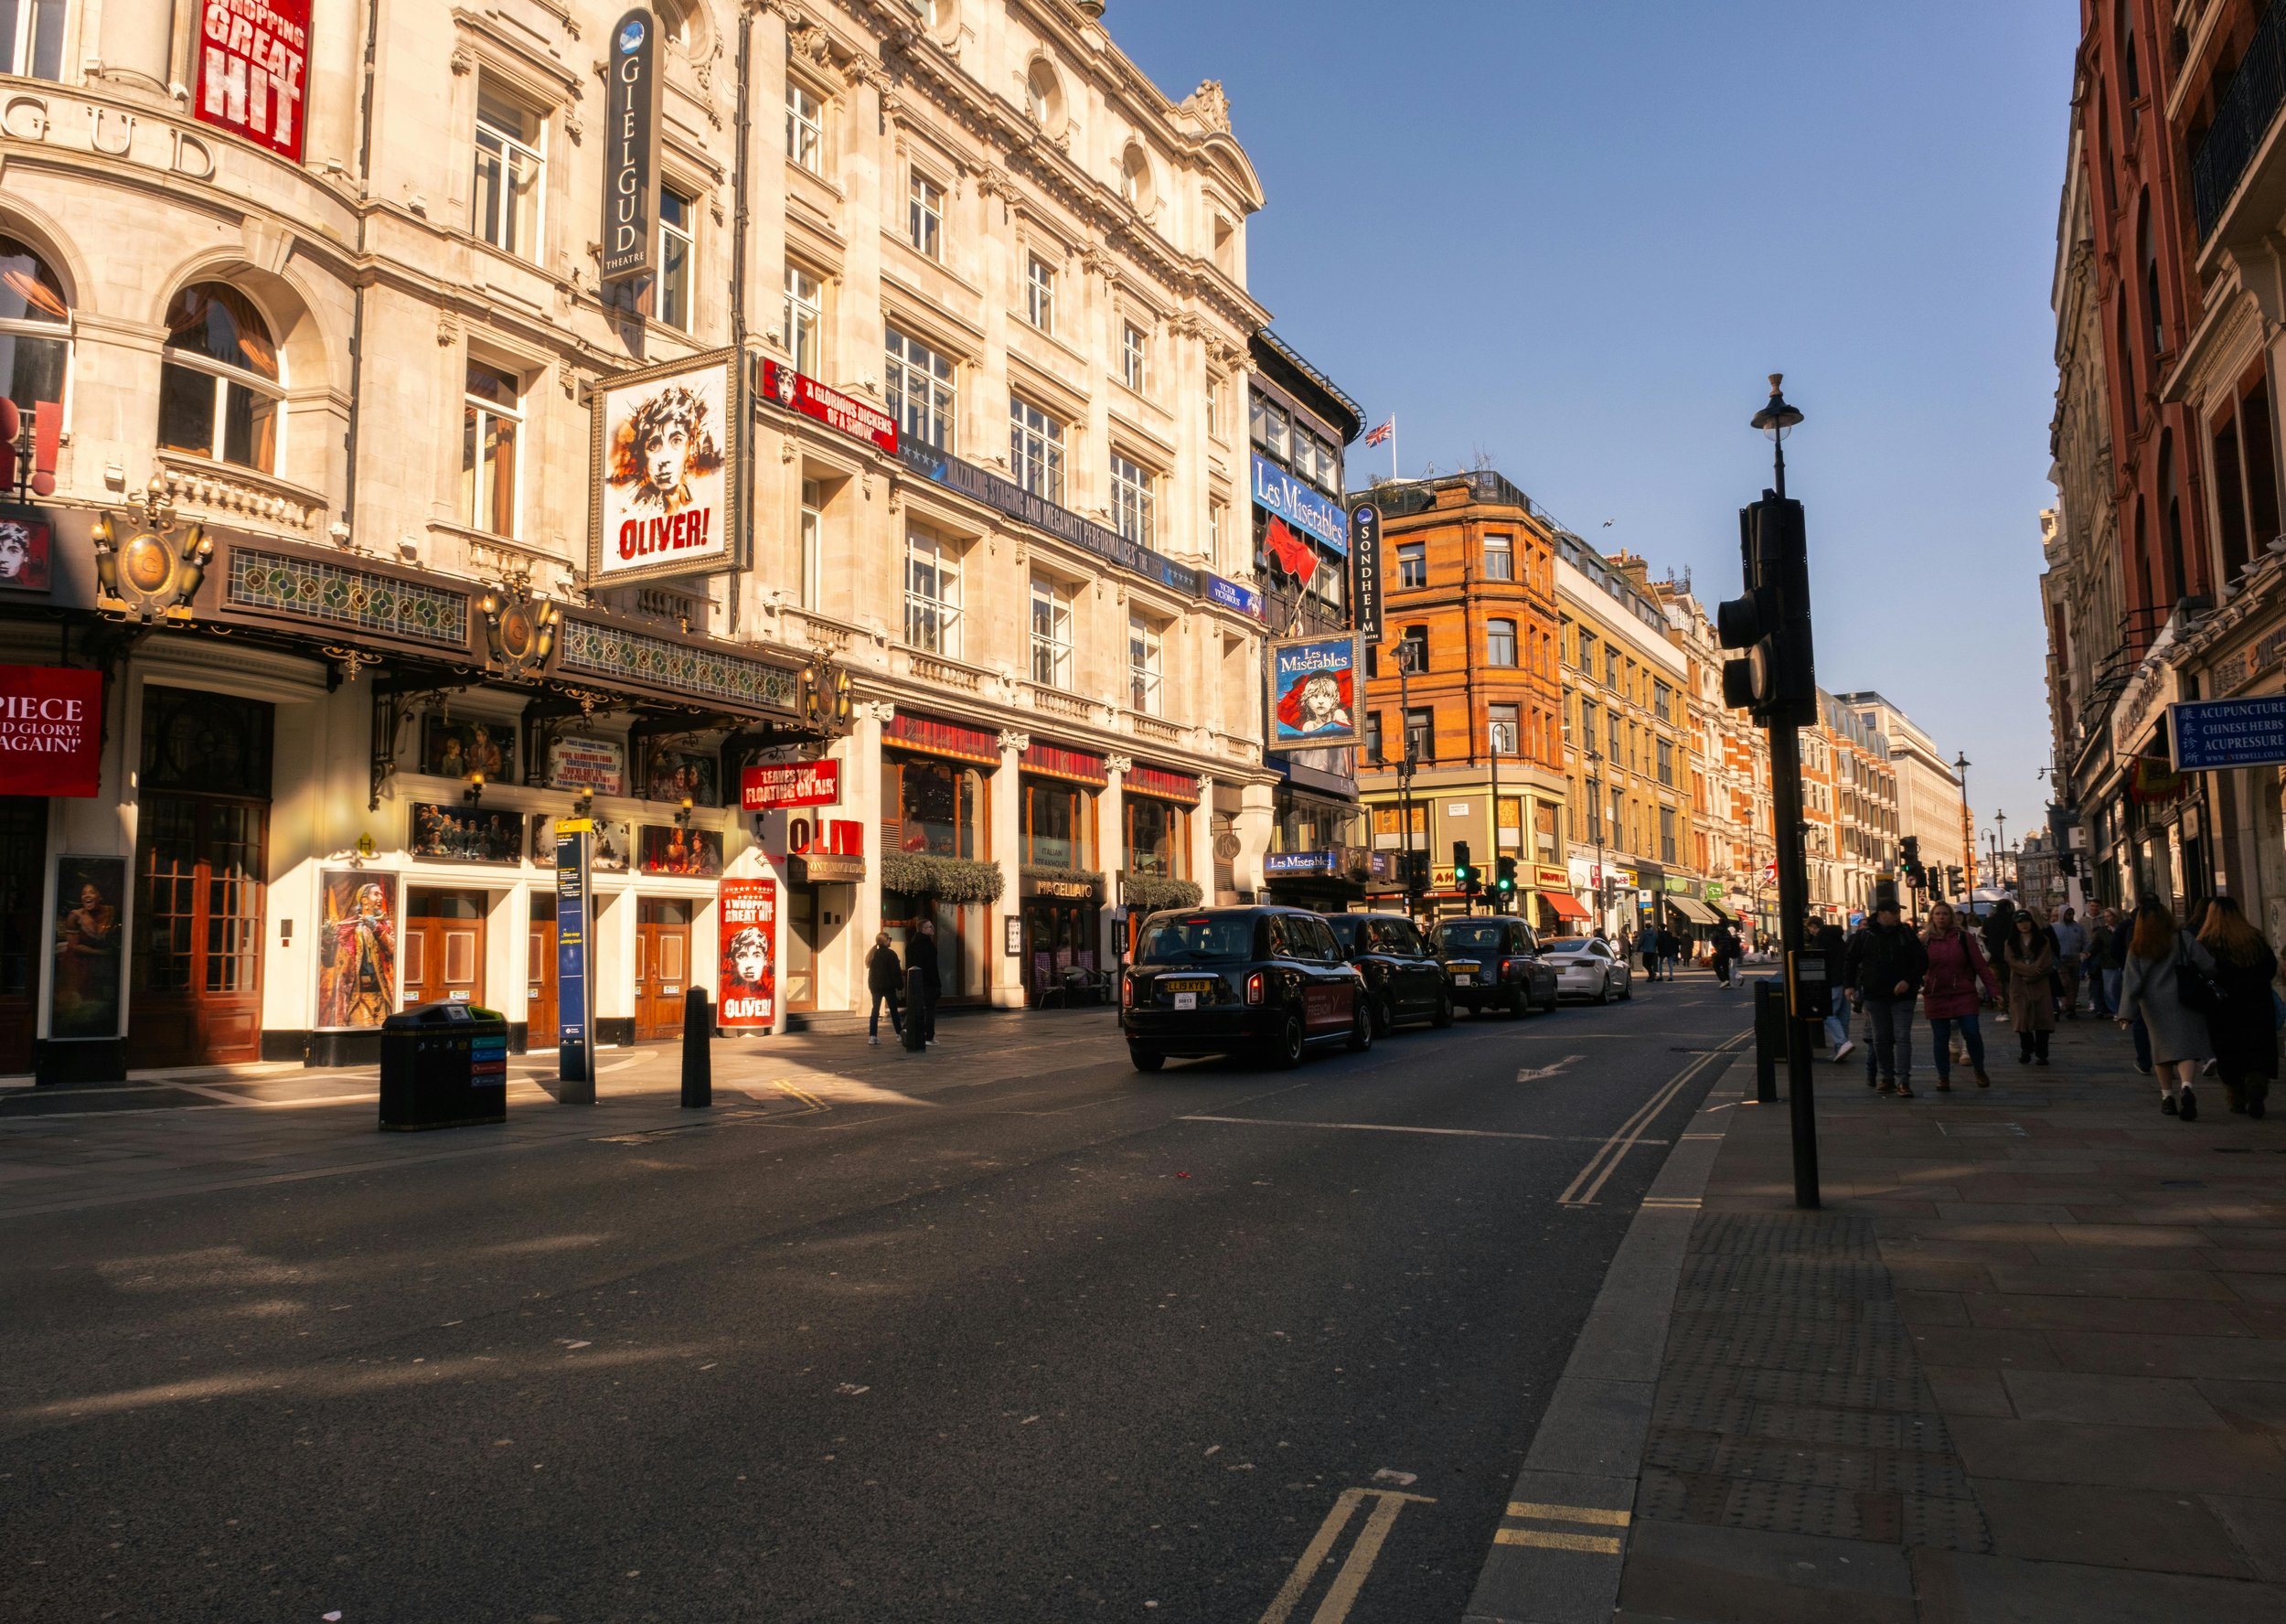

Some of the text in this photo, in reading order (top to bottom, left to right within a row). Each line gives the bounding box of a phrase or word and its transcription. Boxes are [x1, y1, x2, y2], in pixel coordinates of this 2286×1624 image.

[205, 3, 304, 88] GREAT
[204, 45, 302, 146] HIT
[615, 56, 641, 253] GIELGUD
[605, 251, 646, 271] THEATRE
[814, 386, 857, 420] GLORIOUS
[857, 405, 893, 437] DICKENS
[826, 407, 839, 427] OF
[839, 413, 847, 430] A
[989, 477, 1025, 514] STAGING
[1025, 495, 1042, 523] AND
[1042, 502, 1084, 542] MEGAWATT
[1257, 460, 1344, 548] Les Misérables
[616, 507, 711, 561] OLIVER!
[1360, 525, 1376, 633] SONDHEIM
[1213, 587, 1242, 607] VICTORIOUS
[1218, 581, 1237, 597] VICTOR
[1280, 652, 1348, 673] Misérables
[1304, 647, 1321, 660] Les
[2199, 702, 2286, 720] ACUPUNCTURE
[18, 722, 80, 737] GLORY!
[2202, 719, 2284, 735] CHINESE HERBS
[2204, 734, 2285, 751] ACUPRESSURE
[761, 767, 817, 784] 'LEAVES YOU
[745, 783, 796, 804] FLOATING
[796, 778, 813, 798] ON
[359, 839, 372, 849] H
[1042, 847, 1063, 857] ITALIAN
[1034, 858, 1070, 869] STEAKHOUSE
[1270, 855, 1331, 869] Les Misérables
[1036, 881, 1093, 898] MACELLAIO
[732, 899, 774, 911] WHOPPING
[725, 909, 774, 923] GREAT HIT
[1169, 980, 1187, 991] LL19
[723, 998, 772, 1019] OLIVER!
